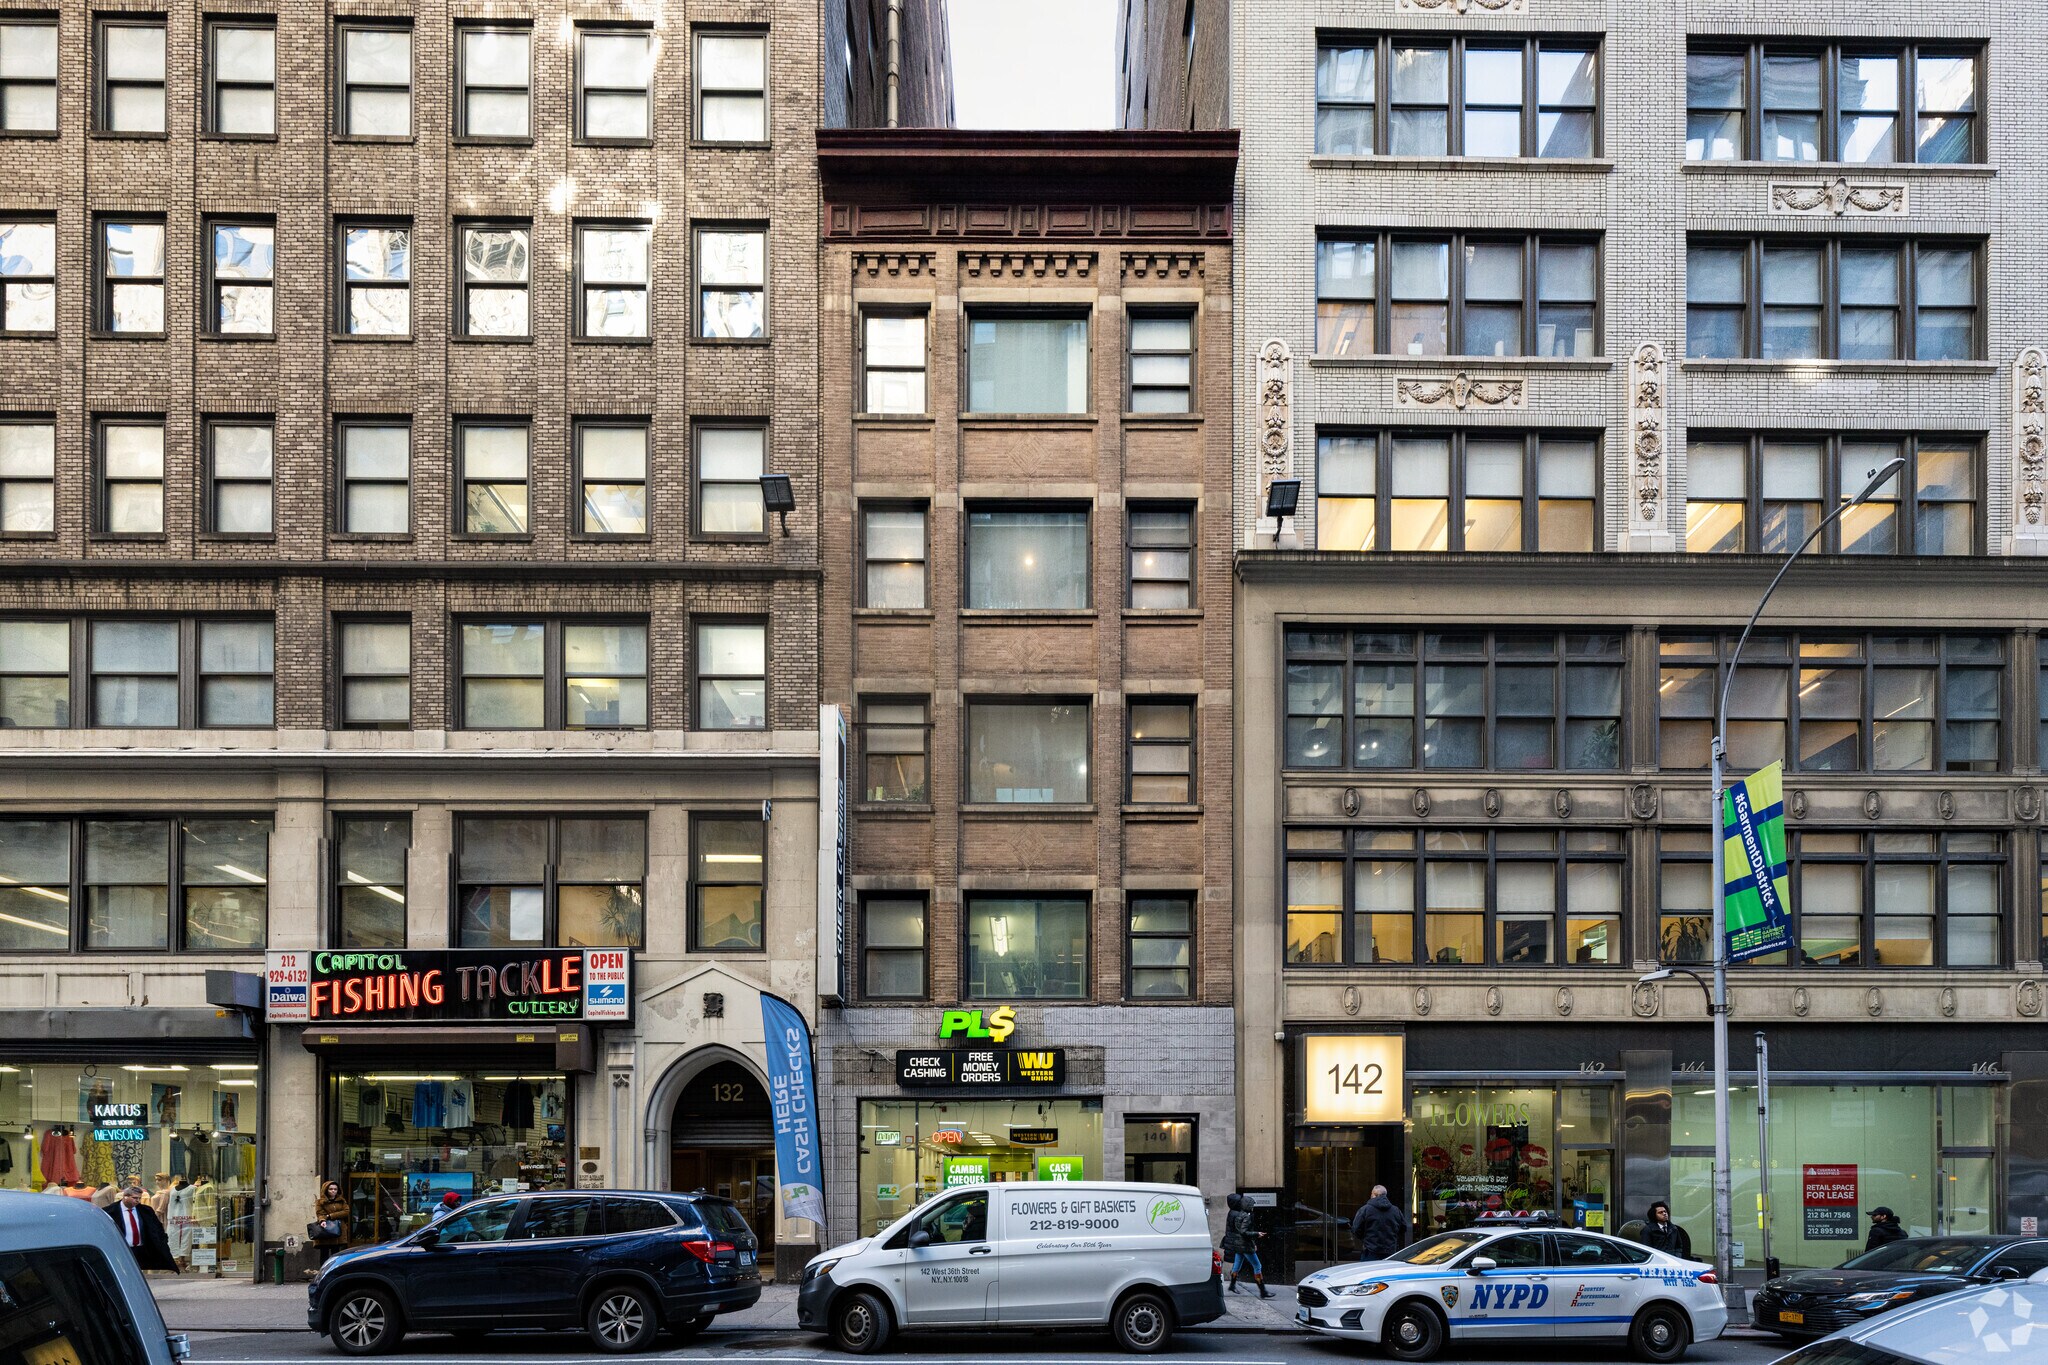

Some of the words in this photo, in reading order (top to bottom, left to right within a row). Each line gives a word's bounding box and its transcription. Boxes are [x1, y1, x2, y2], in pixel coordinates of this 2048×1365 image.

[1734, 792, 1774, 908] #GarmentDistrict
[282, 955, 296, 967] 212
[316, 952, 408, 974] CAPITOL
[590, 953, 624, 969] OPEN
[269, 970, 307, 982] 929-6132
[590, 972, 596, 980] TO
[597, 972, 606, 980] THE
[608, 972, 624, 980] PUBLIC
[310, 970, 445, 1017] FISHING
[456, 956, 582, 1002] TACKLE
[271, 992, 306, 1002] Daiwa
[508, 998, 580, 1014] CUTLERY
[910, 1057, 940, 1067] CHECK
[968, 1052, 993, 1062] FREE
[1018, 1052, 1054, 1069] WU
[904, 1068, 947, 1078] CASHING
[962, 1062, 999, 1072] MONEY
[1579, 1061, 1606, 1075] 142
[1680, 1061, 1704, 1075] 144
[1972, 1062, 1998, 1076] 146
[961, 1073, 1001, 1082] ORDERS
[1328, 1063, 1383, 1094] 142
[712, 1083, 744, 1102] 132
[94, 1104, 141, 1116] KAKTUS
[1430, 1103, 1531, 1127] FLOWERS
[877, 1132, 899, 1141] ATM
[932, 1130, 962, 1143] OPEN
[1143, 1132, 1167, 1141] 140
[950, 1165, 982, 1174] CAMBIE
[1049, 1164, 1072, 1173] CASH
[948, 1175, 985, 1184] CHEQUES
[1052, 1173, 1069, 1181] TAX
[1012, 1201, 1057, 1215] FLOWERS
[1061, 1202, 1068, 1214] &
[1070, 1201, 1092, 1214] GIFT
[1094, 1200, 1136, 1213] BASKETS
[1030, 1218, 1119, 1230] 212-819-9000
[1036, 1242, 1069, 1250] Celebrating
[1098, 1241, 1112, 1249] Year
[1640, 1268, 1694, 1278] TRAFFIC
[1470, 1284, 1549, 1309] NYPD
